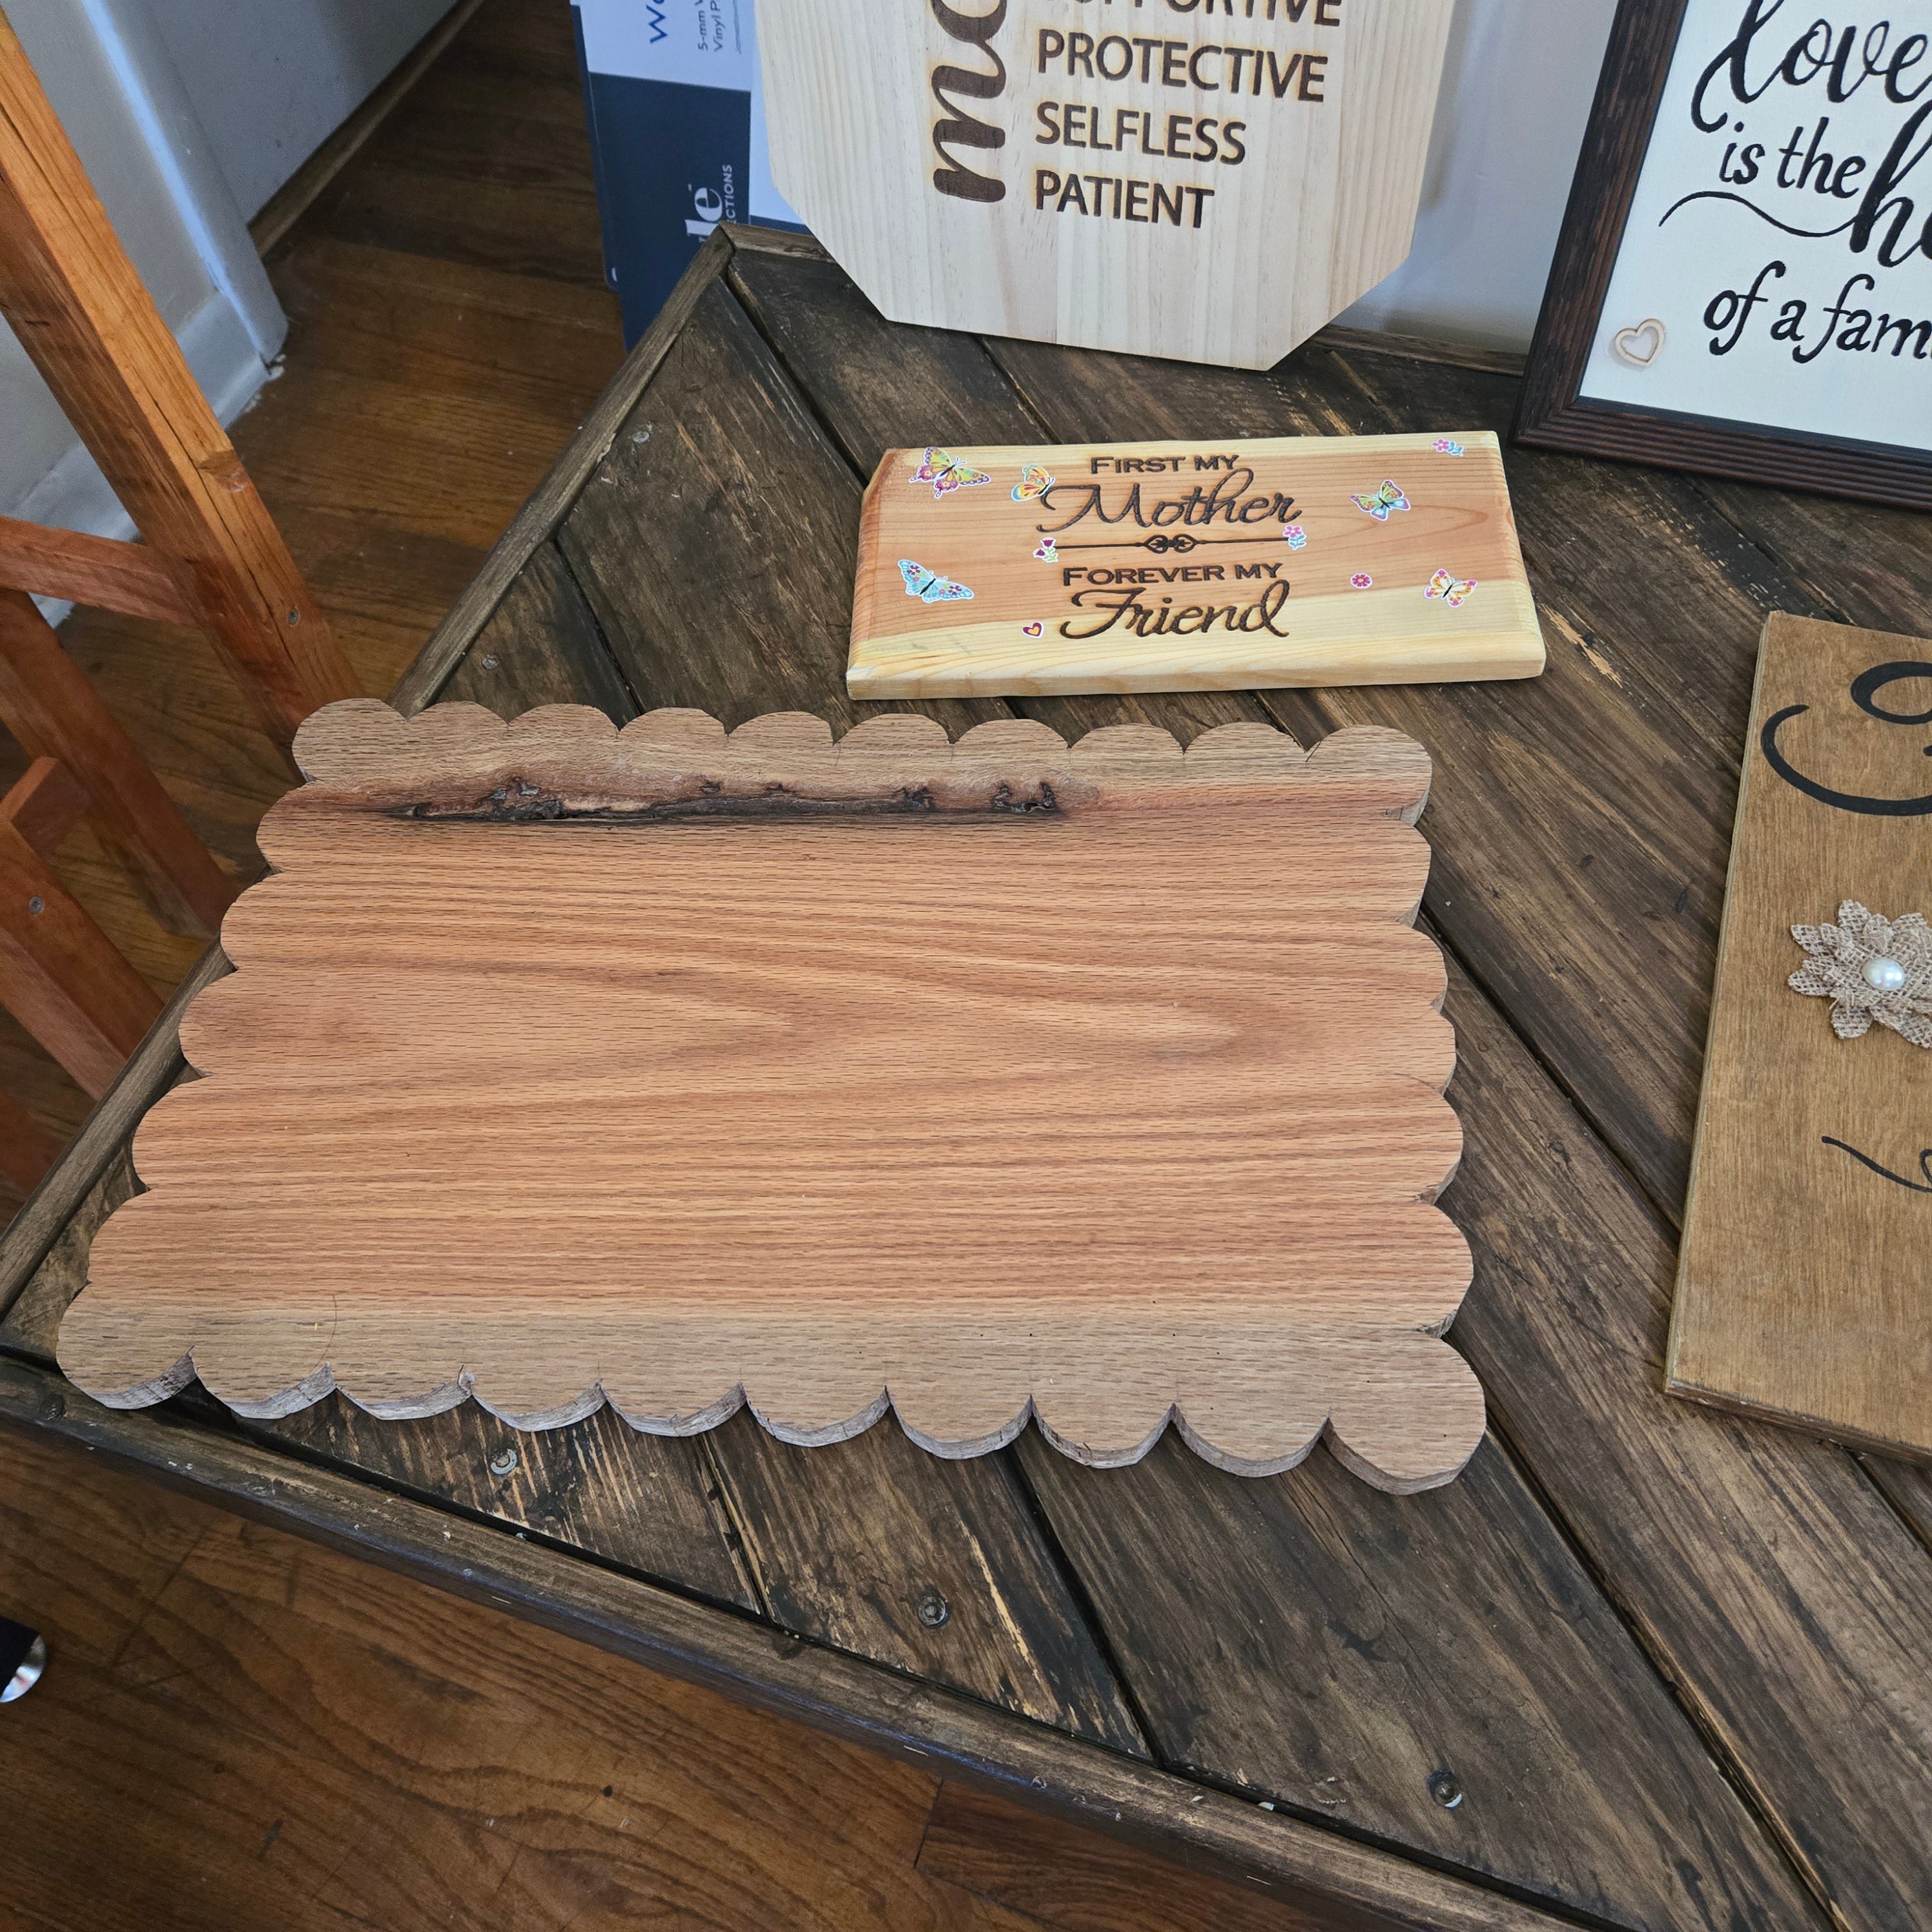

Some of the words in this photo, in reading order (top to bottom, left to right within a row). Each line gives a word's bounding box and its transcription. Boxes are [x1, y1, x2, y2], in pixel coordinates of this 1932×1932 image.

[646, 0, 668, 44] W
[697, 10, 708, 51] 5-mm
[711, 14, 725, 52] Vinyl
[1037, 28, 1328, 103] PROTECTIVE
[1035, 101, 1246, 165] SELFLESS
[1719, 121, 1765, 184] is
[1778, 117, 1865, 198] the
[722, 164, 737, 223] CTIONS
[1035, 169, 1215, 229] PATIENT
[1703, 260, 1786, 356] of
[1770, 300, 1807, 341] a
[1792, 273, 1932, 364] fam
[1090, 455, 1186, 475] FIRST
[1193, 454, 1240, 471] MY
[1036, 468, 1302, 533] Mother
[1063, 564, 1225, 586] FOREVER
[1235, 562, 1284, 580] MY
[1060, 579, 1290, 639] Friend
